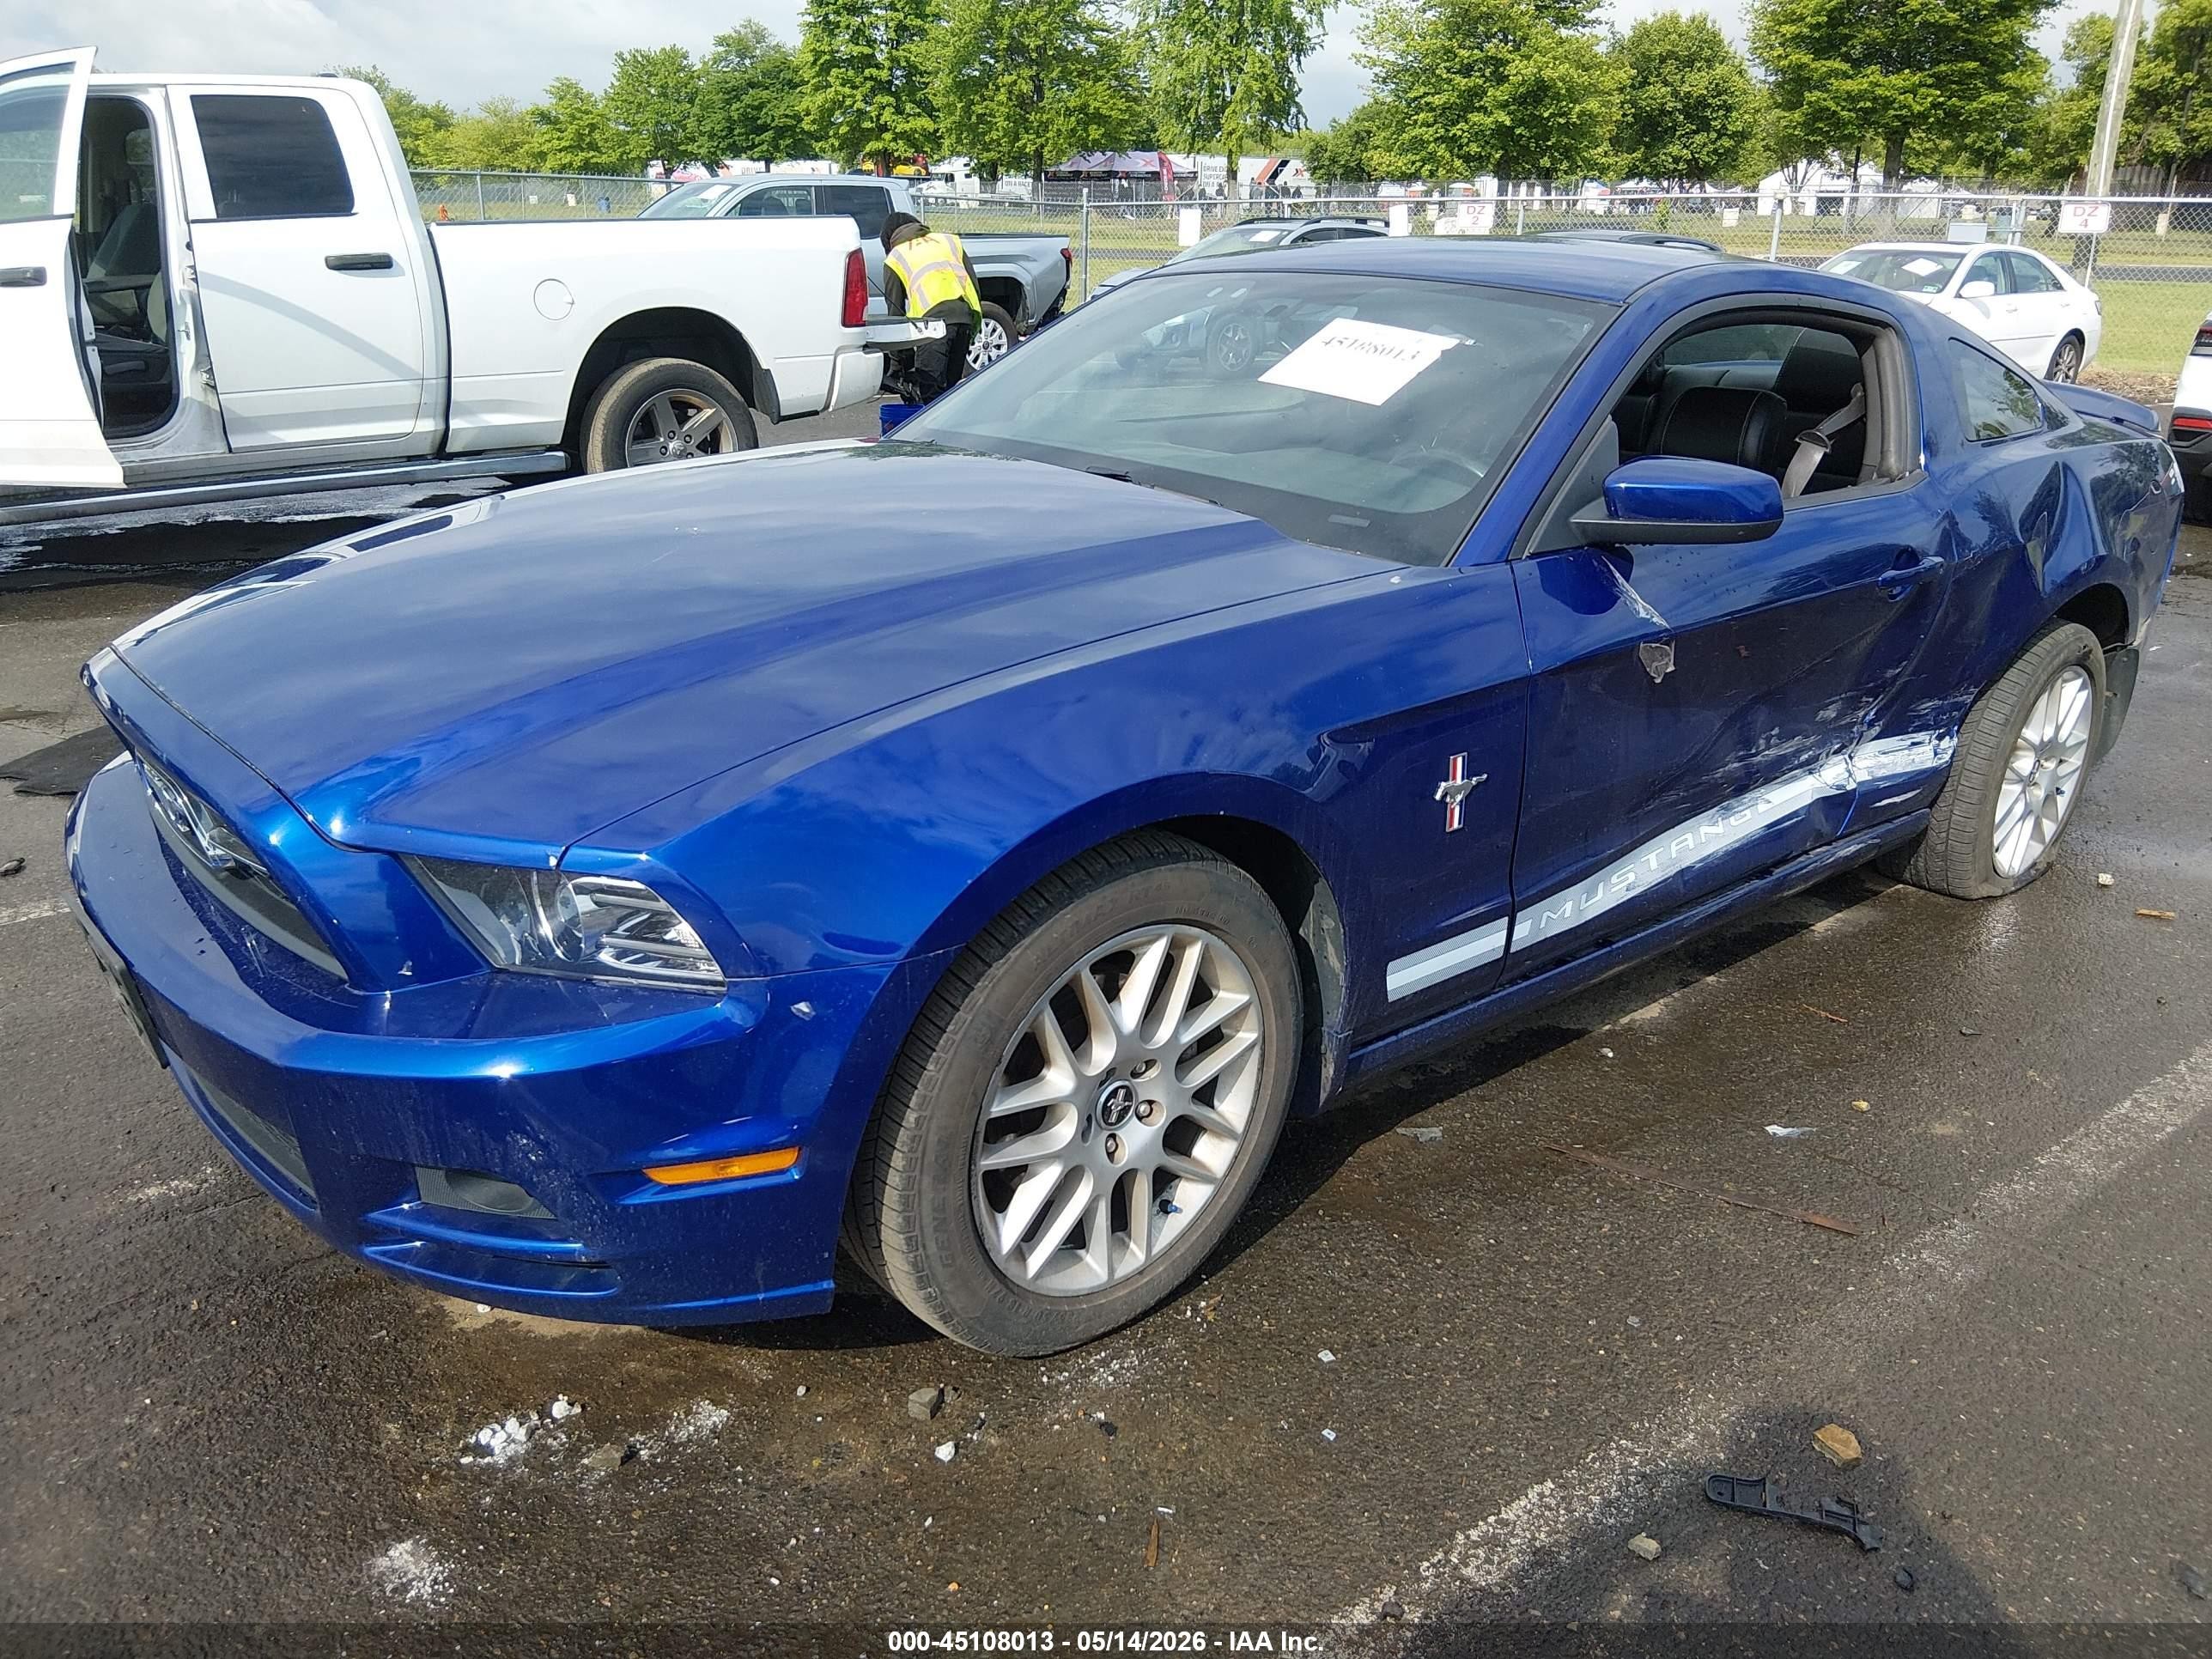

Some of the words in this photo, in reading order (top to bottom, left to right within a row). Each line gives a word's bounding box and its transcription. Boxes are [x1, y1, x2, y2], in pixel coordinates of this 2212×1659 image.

[1467, 205, 1486, 215] DZ
[2074, 206, 2100, 216] DZ
[1472, 216, 1479, 225] 2
[2079, 218, 2088, 228] 4
[1539, 808, 1753, 931] MUSTANG
